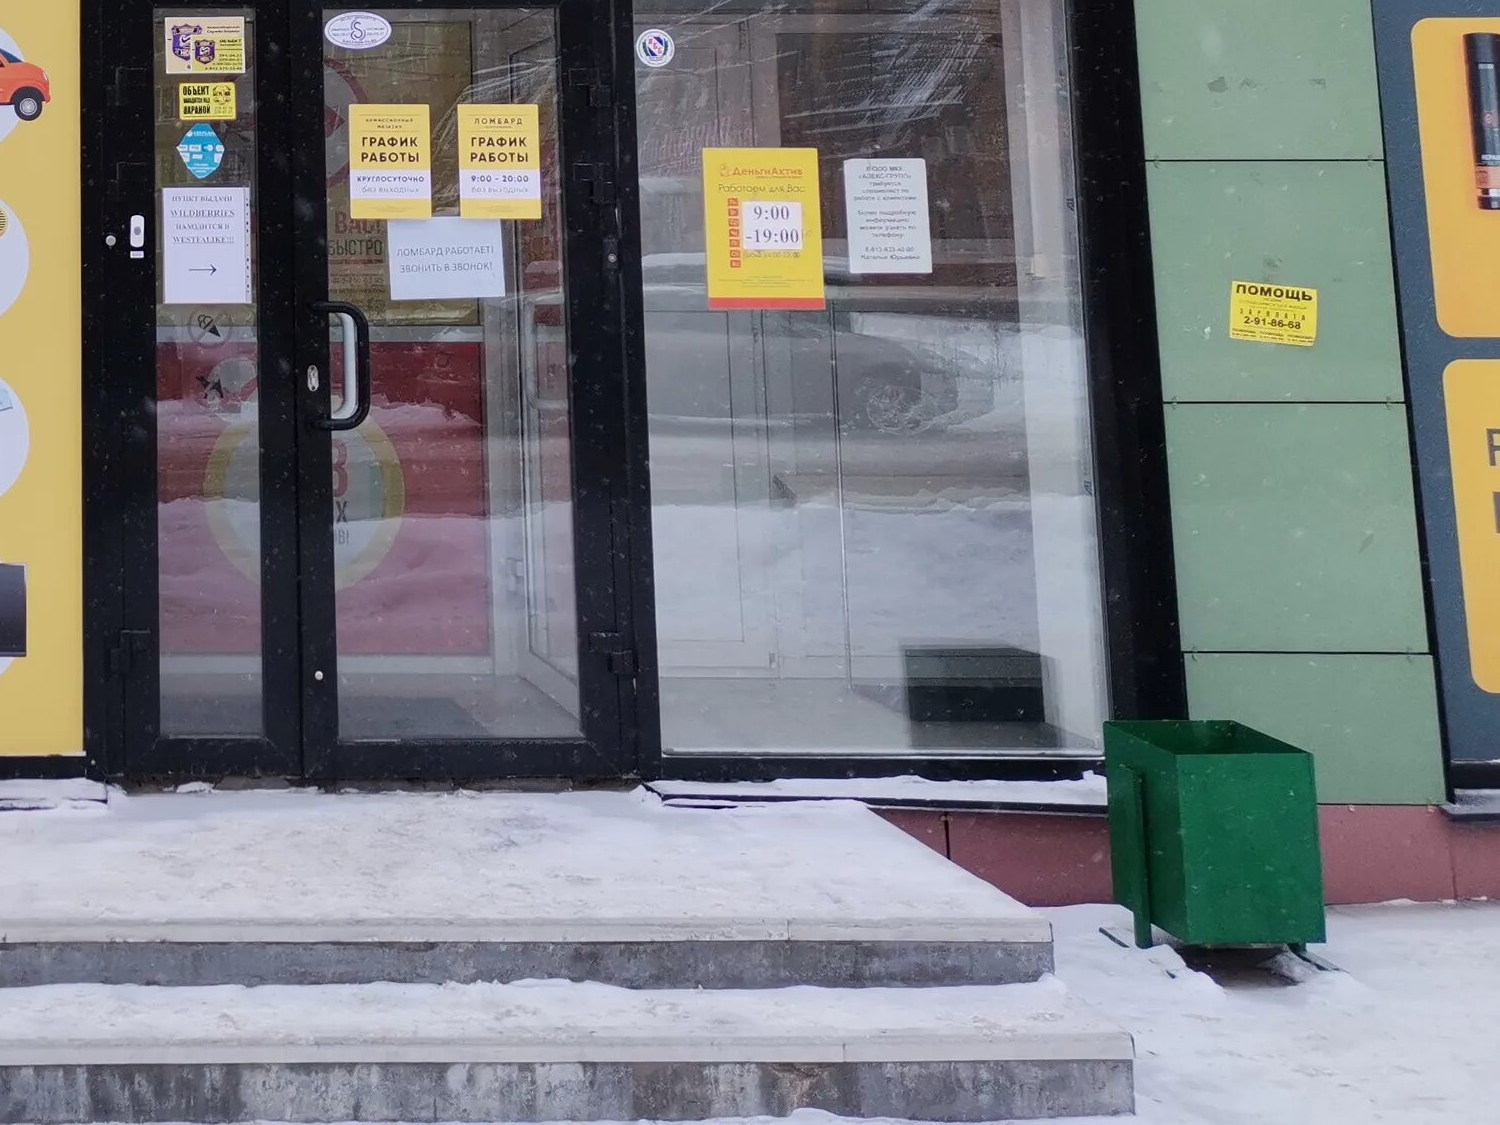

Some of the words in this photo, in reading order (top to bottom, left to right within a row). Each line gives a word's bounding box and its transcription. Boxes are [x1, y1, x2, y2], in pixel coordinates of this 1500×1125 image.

[182, 85, 210, 96] ОБЪЕКТ
[183, 104, 211, 115] ОХРАНОЙ
[474, 117, 523, 125] ЛОМБАРД
[361, 136, 419, 147] ГРАФИК
[471, 136, 527, 147] ГРАФИК
[361, 152, 420, 162] РАБОТЫ
[470, 152, 529, 162] РАБОТЫ
[718, 184, 766, 194] Работаем
[170, 209, 236, 217] WILDBERRIES
[753, 205, 789, 220] 9:00
[745, 228, 799, 243] -19:00
[396, 247, 444, 258] ЛОМБАРД
[445, 245, 494, 256] РАБОТАЕТ!
[400, 264, 442, 273] ЗВОНИТЬ
[452, 262, 493, 271] ЗВОНОК!
[1236, 283, 1313, 302] ПОМОЩЬ
[1243, 315, 1302, 330] 2-91-86-68
